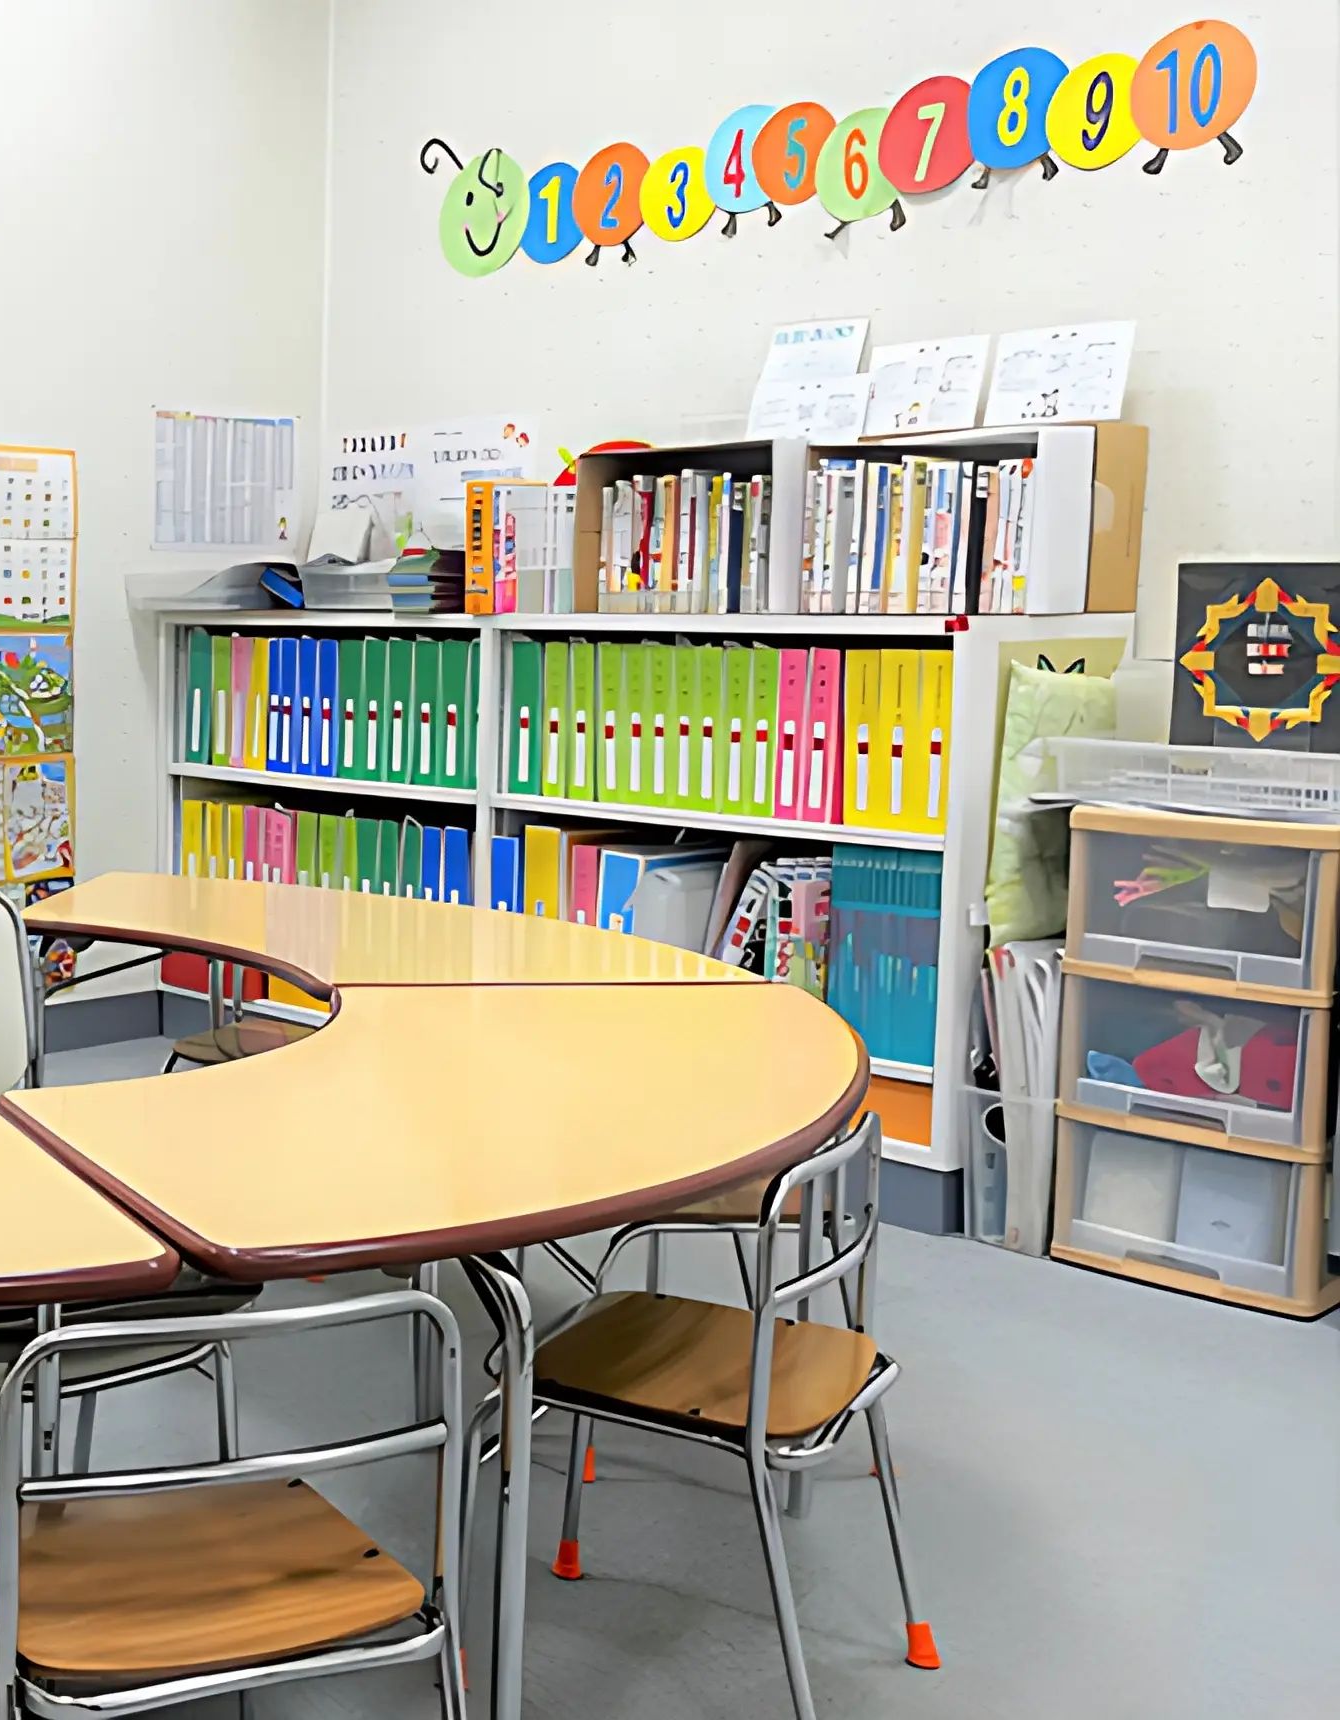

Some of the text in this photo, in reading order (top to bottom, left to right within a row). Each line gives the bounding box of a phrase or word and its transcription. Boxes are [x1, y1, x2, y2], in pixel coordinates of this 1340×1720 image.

[539, 43, 1222, 244] 1 2 3 4 5 6 7 8 9 10
